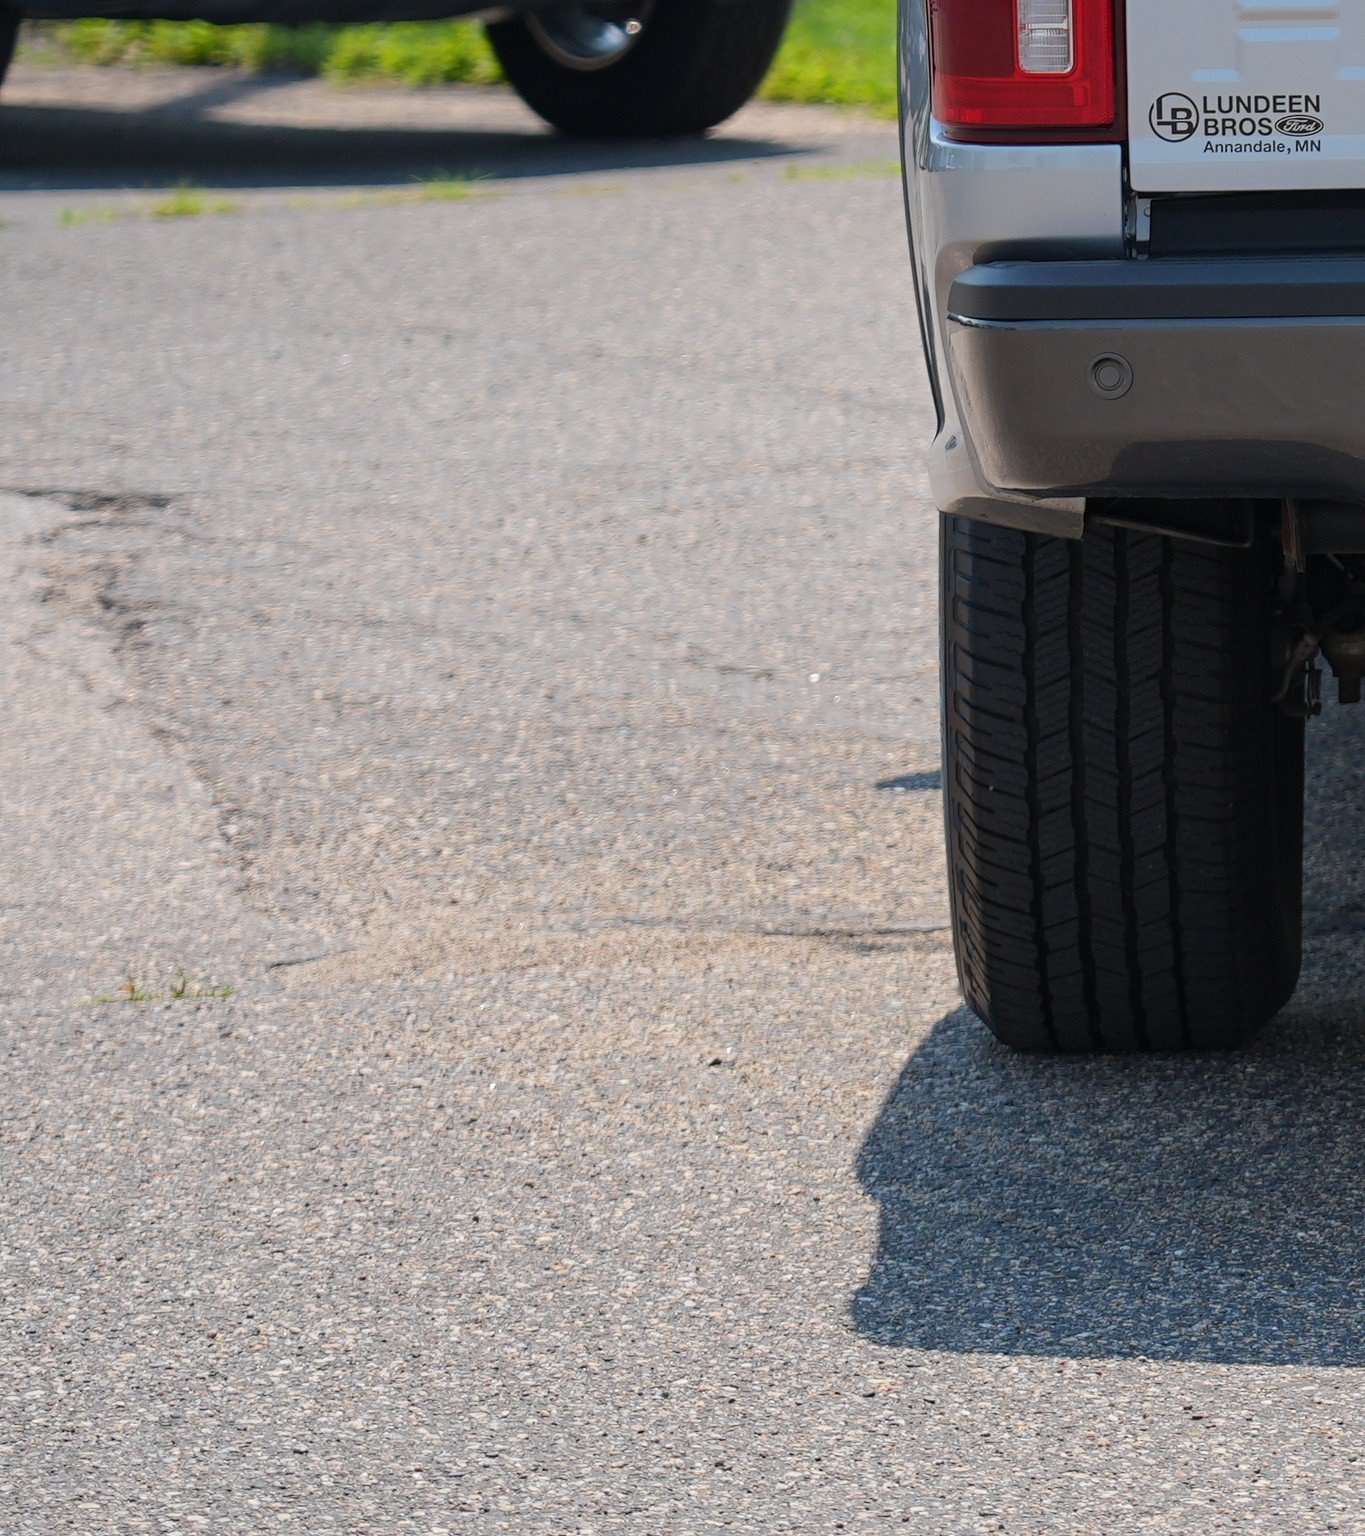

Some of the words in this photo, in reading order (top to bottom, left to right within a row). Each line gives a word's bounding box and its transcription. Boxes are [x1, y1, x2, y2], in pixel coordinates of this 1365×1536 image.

[1203, 95, 1320, 114] LUNDEEN
[1204, 118, 1273, 136] BROS
[1203, 140, 1291, 154] Annandale,
[1295, 140, 1321, 152] MN
